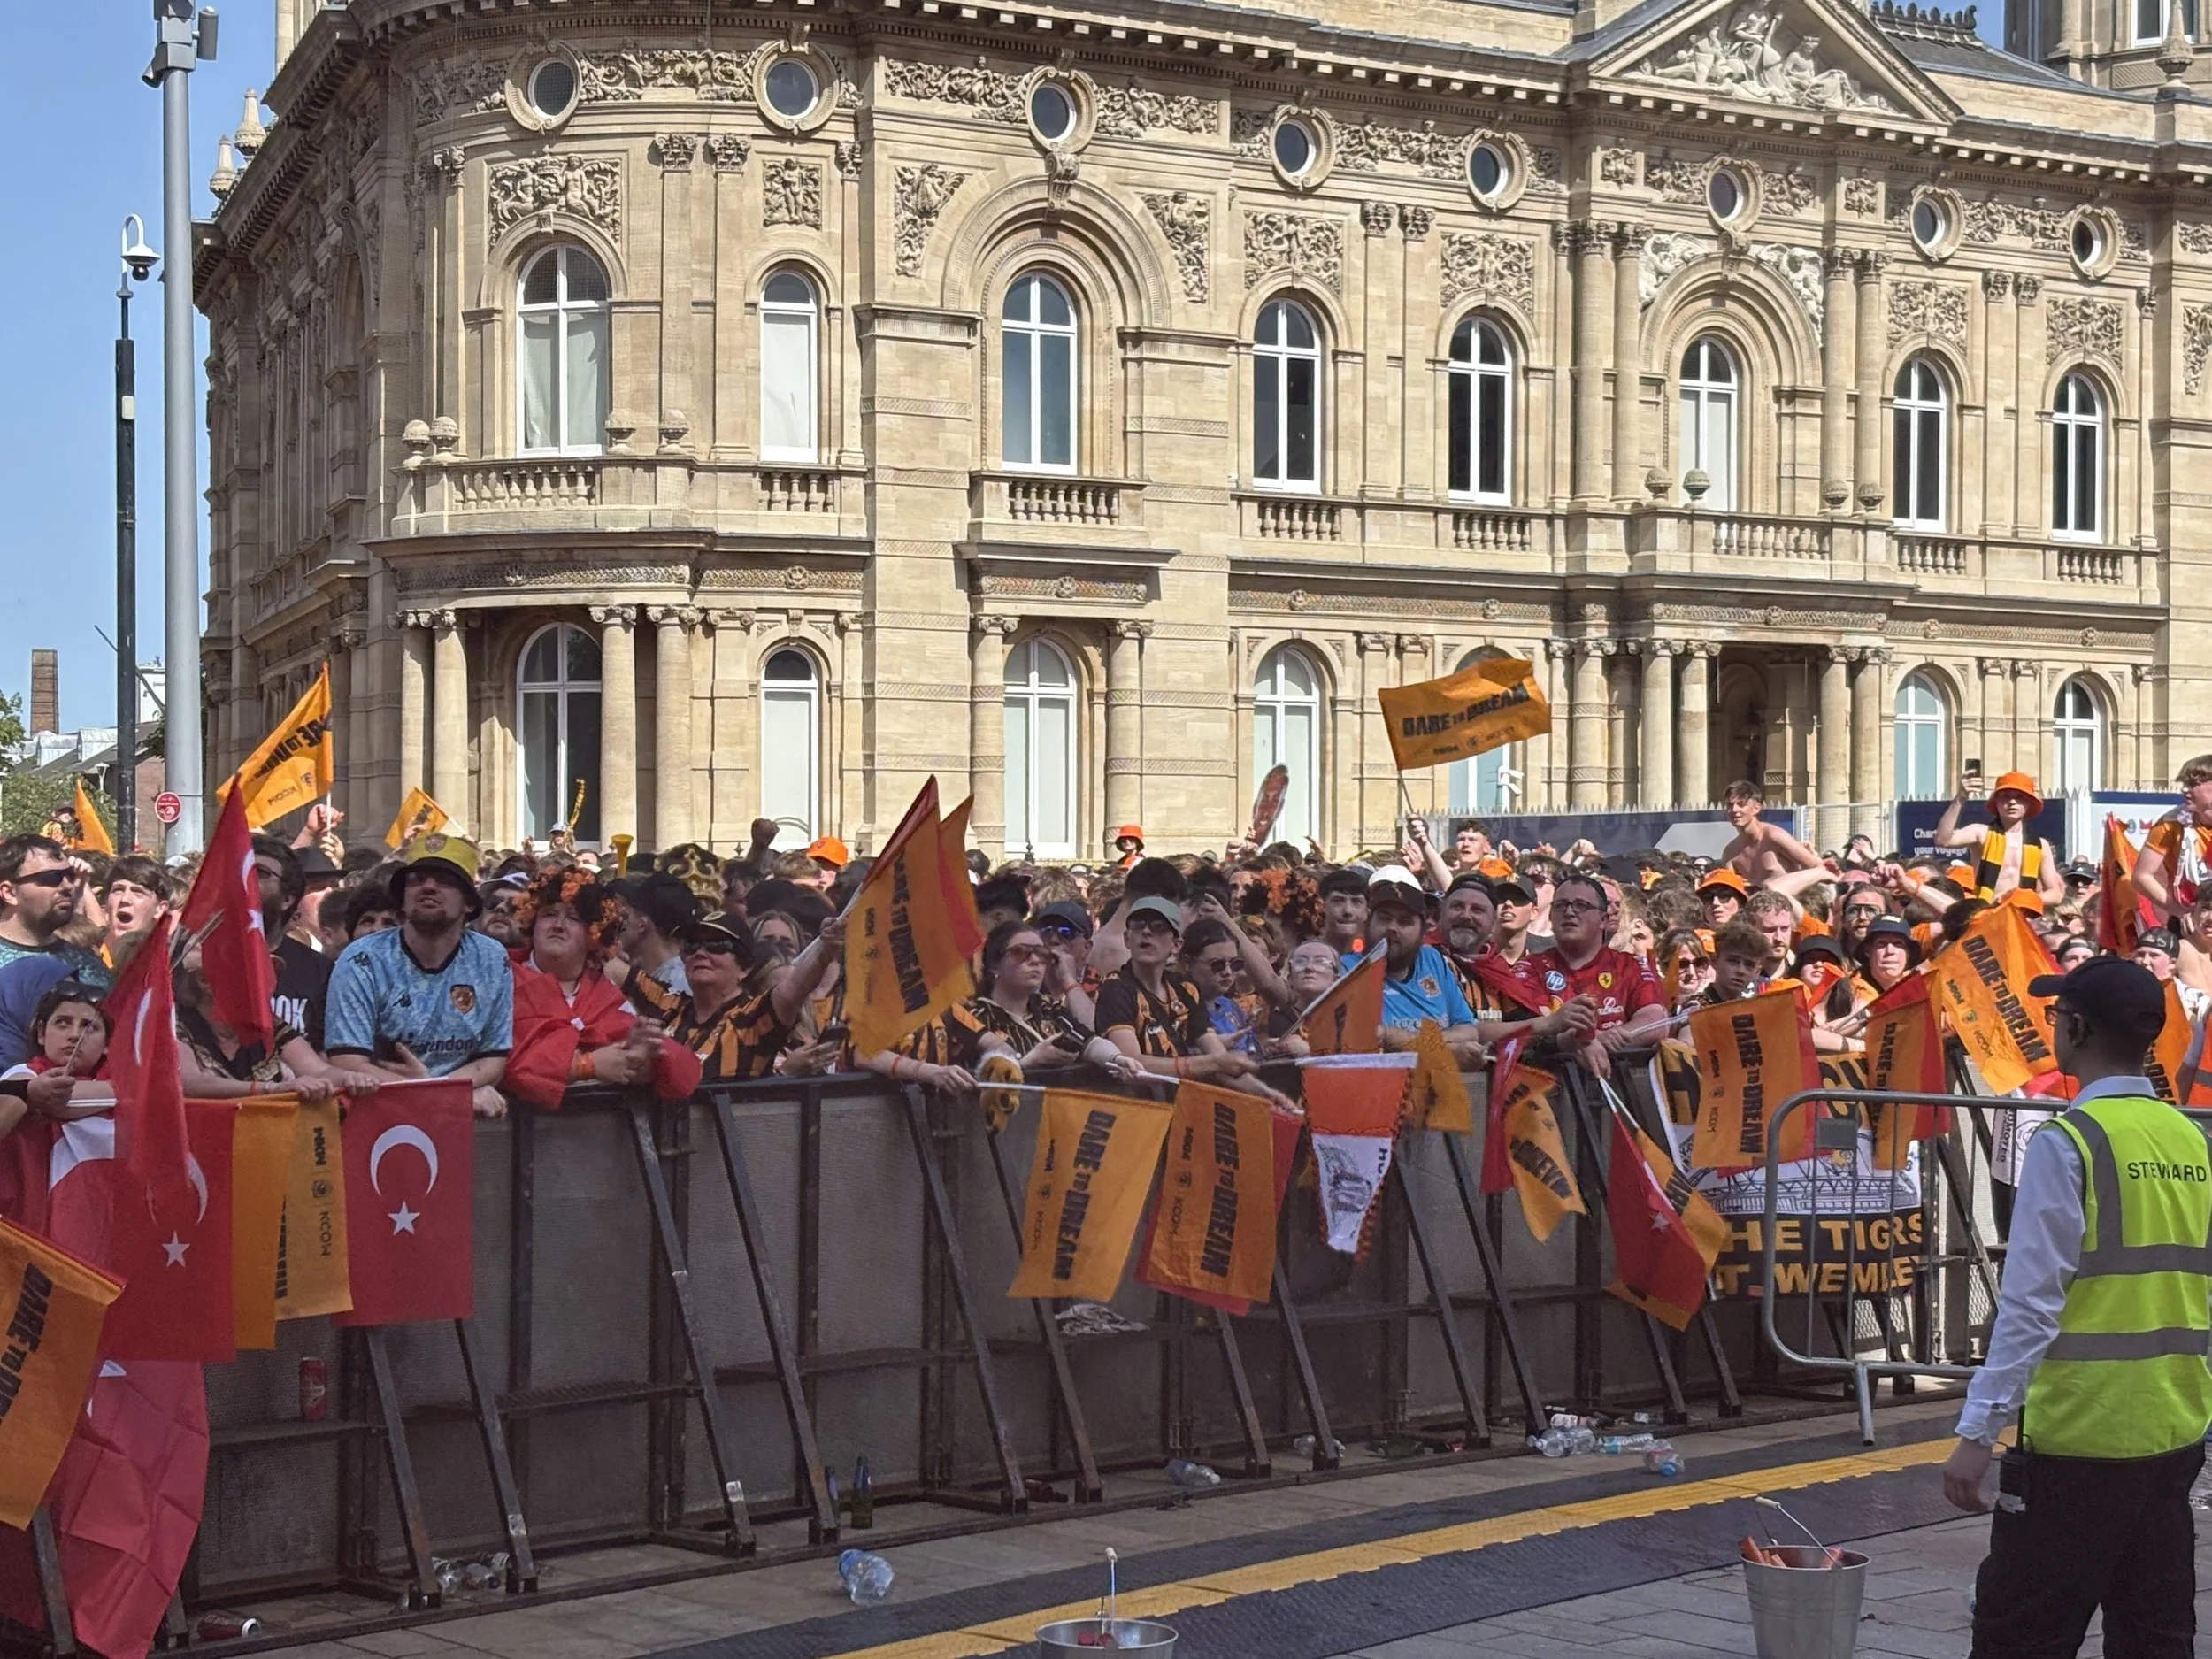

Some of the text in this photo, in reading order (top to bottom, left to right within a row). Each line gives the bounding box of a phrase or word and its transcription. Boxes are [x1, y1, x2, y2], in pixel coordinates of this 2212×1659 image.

[1402, 712, 1451, 738] DARE
[1914, 828, 1938, 840] Char
[1914, 846, 1935, 859] your
[888, 925, 931, 1014] DREAM
[1548, 971, 1564, 990] hp
[270, 995, 309, 1033] OK
[1962, 934, 2051, 1064] DARE TO DREAM
[1875, 1021, 1898, 1071] DARE
[1974, 1029, 1994, 1059] KCOM
[1731, 1014, 1763, 1154] DARE TO DREAM
[2142, 1064, 2177, 1106] DRE
[1200, 1101, 1240, 1279] DARE TO DREAM
[2127, 1161, 2208, 1183] STEWARD
[1052, 1110, 1118, 1281] DARE TO DREAM
[1170, 1196, 1185, 1236] KCOM
[1720, 1219, 1803, 1253] HE
[1714, 1263, 1751, 1296] T
[6, 1261, 53, 1353] DARE
